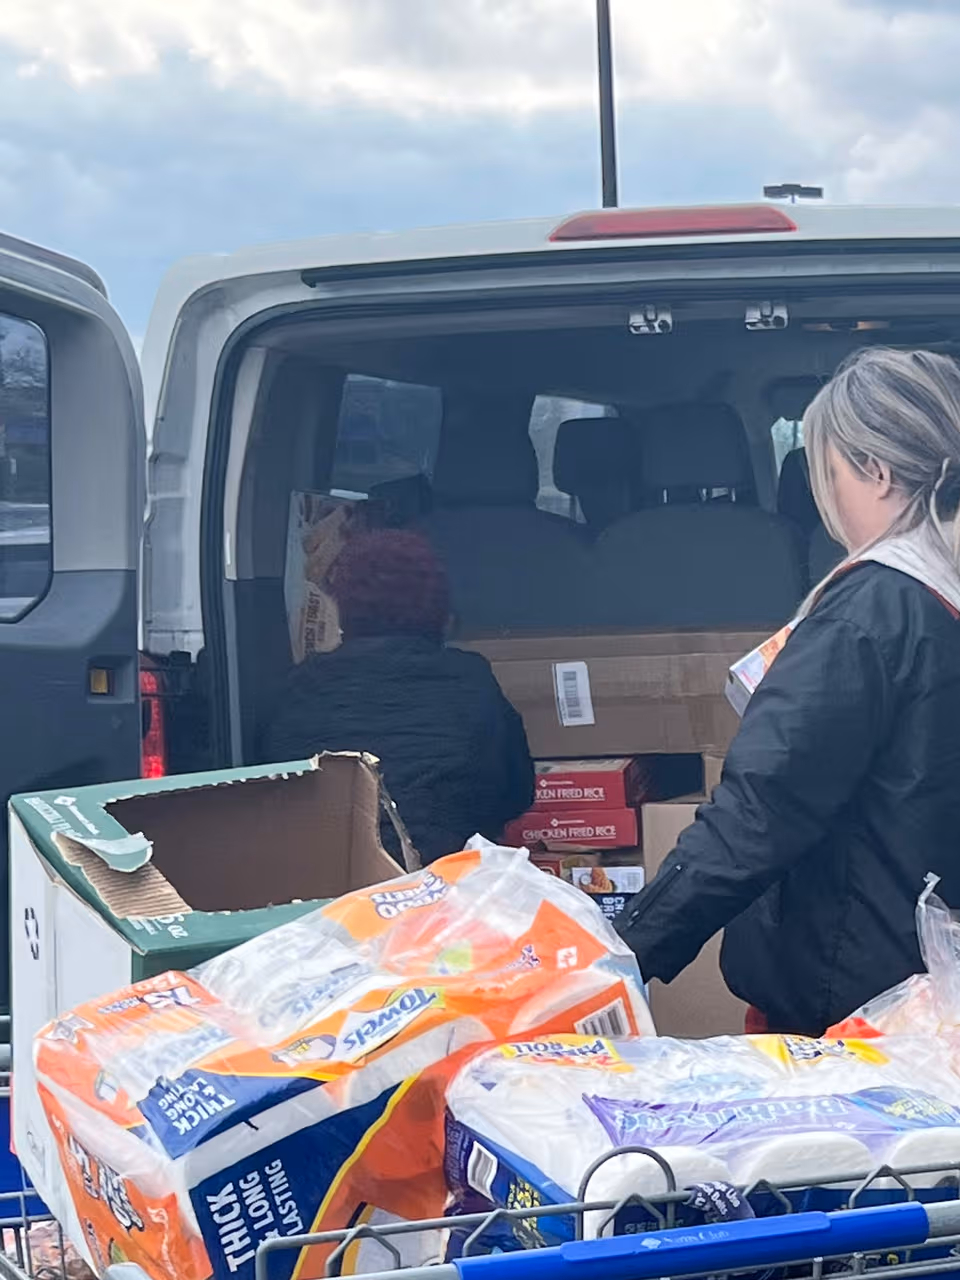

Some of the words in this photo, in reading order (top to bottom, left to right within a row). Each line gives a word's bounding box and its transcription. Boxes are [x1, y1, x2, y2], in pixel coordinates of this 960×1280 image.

[557, 787, 584, 799] FRIED
[584, 787, 605, 798] RICE
[522, 829, 568, 840] CHICKEN
[568, 828, 594, 838] FRIED
[595, 826, 617, 836] RICE
[165, 1089, 207, 1121] LONG
[173, 1094, 236, 1136] THICK
[238, 1171, 274, 1231] LONG
[265, 1159, 304, 1236] LASTING
[206, 1182, 255, 1273] THICK
